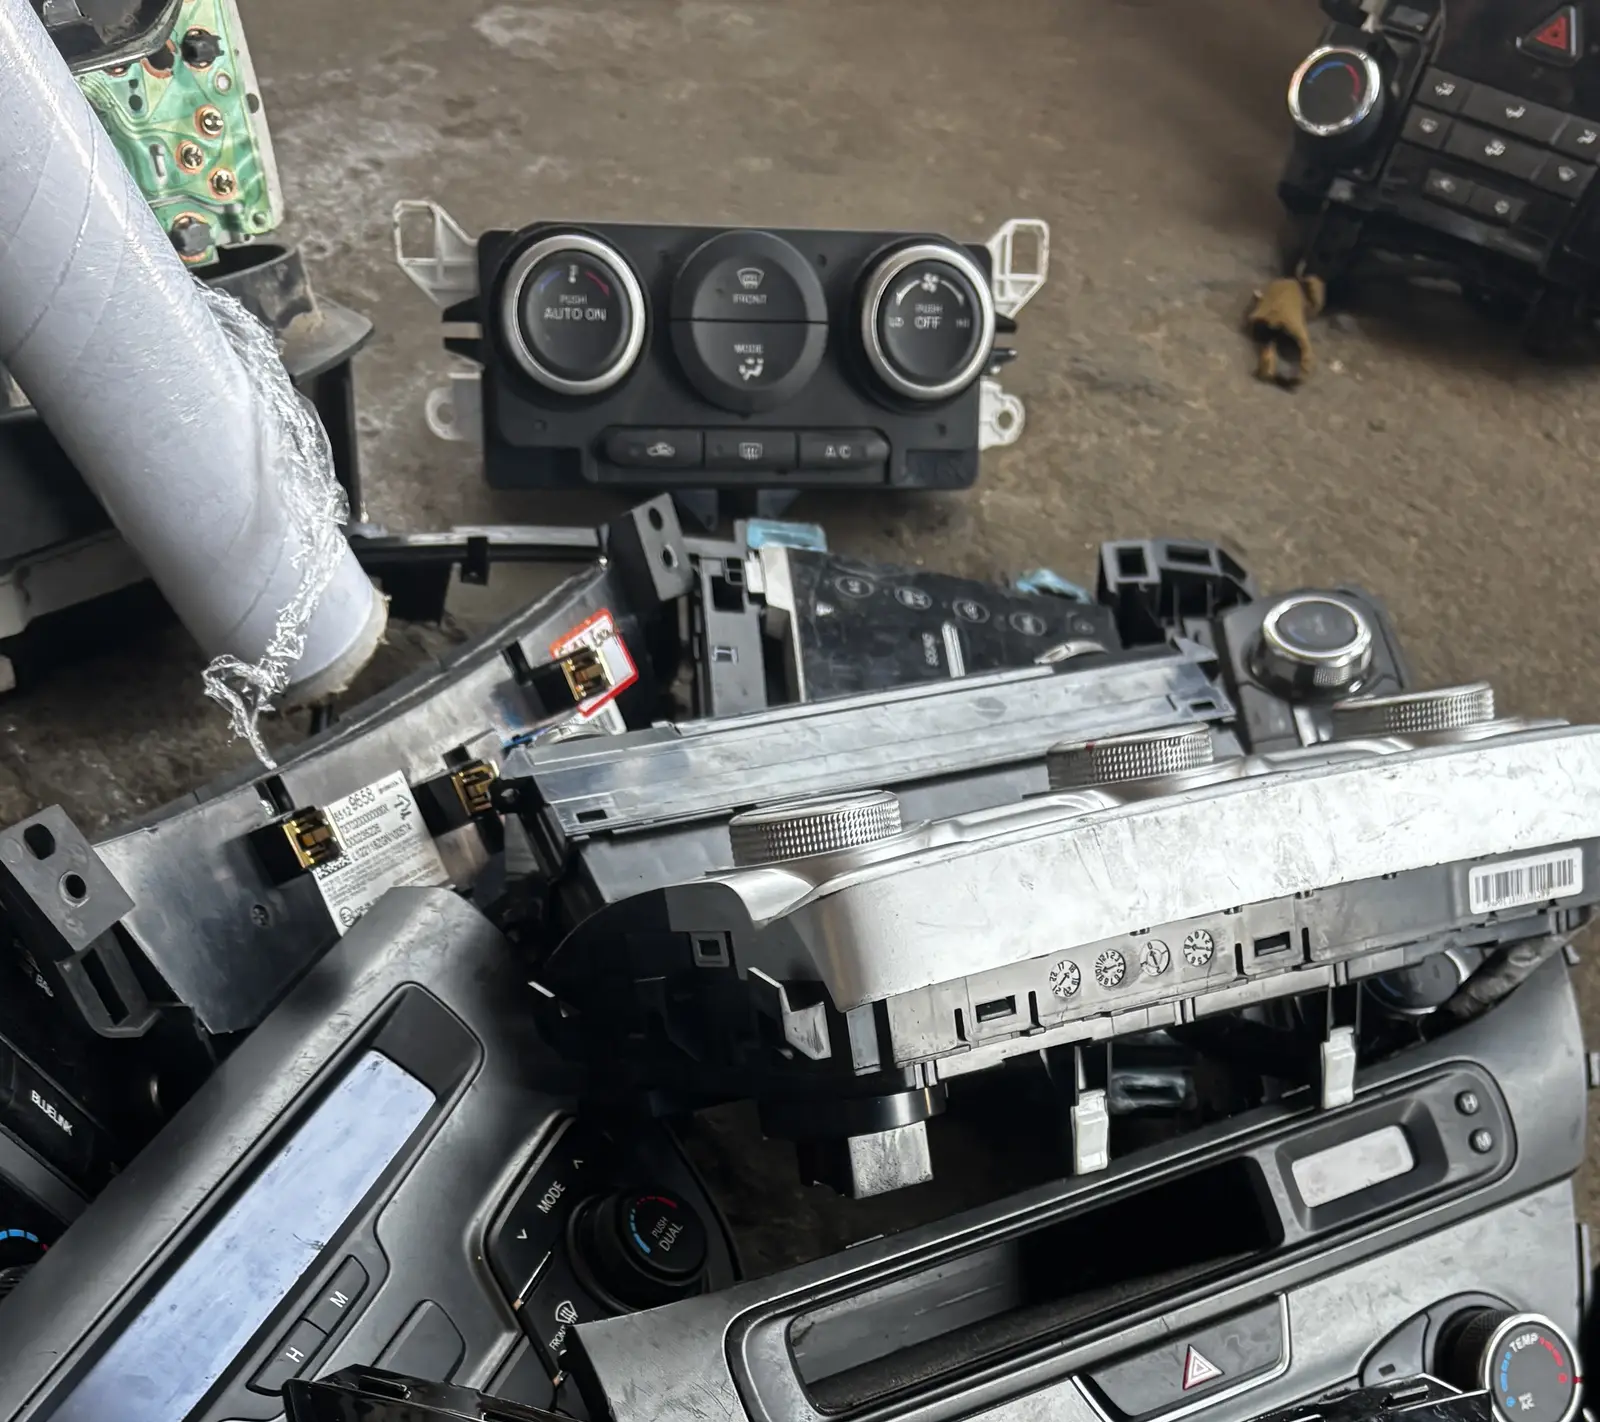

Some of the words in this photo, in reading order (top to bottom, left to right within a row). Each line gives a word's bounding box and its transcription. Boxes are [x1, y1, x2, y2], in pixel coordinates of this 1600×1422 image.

[543, 307, 582, 320] AUTO
[584, 308, 607, 321] ON
[914, 315, 942, 330] OFF
[1462, 1094, 1476, 1109] H
[31, 1089, 73, 1137] BLUELINK
[1476, 1131, 1491, 1150] M
[536, 1180, 566, 1213] MODE
[651, 1216, 668, 1239] PUSH
[658, 1223, 683, 1252] DUAL
[329, 1290, 349, 1308] M
[1509, 1332, 1539, 1352] TEMP
[285, 1346, 304, 1362] H
